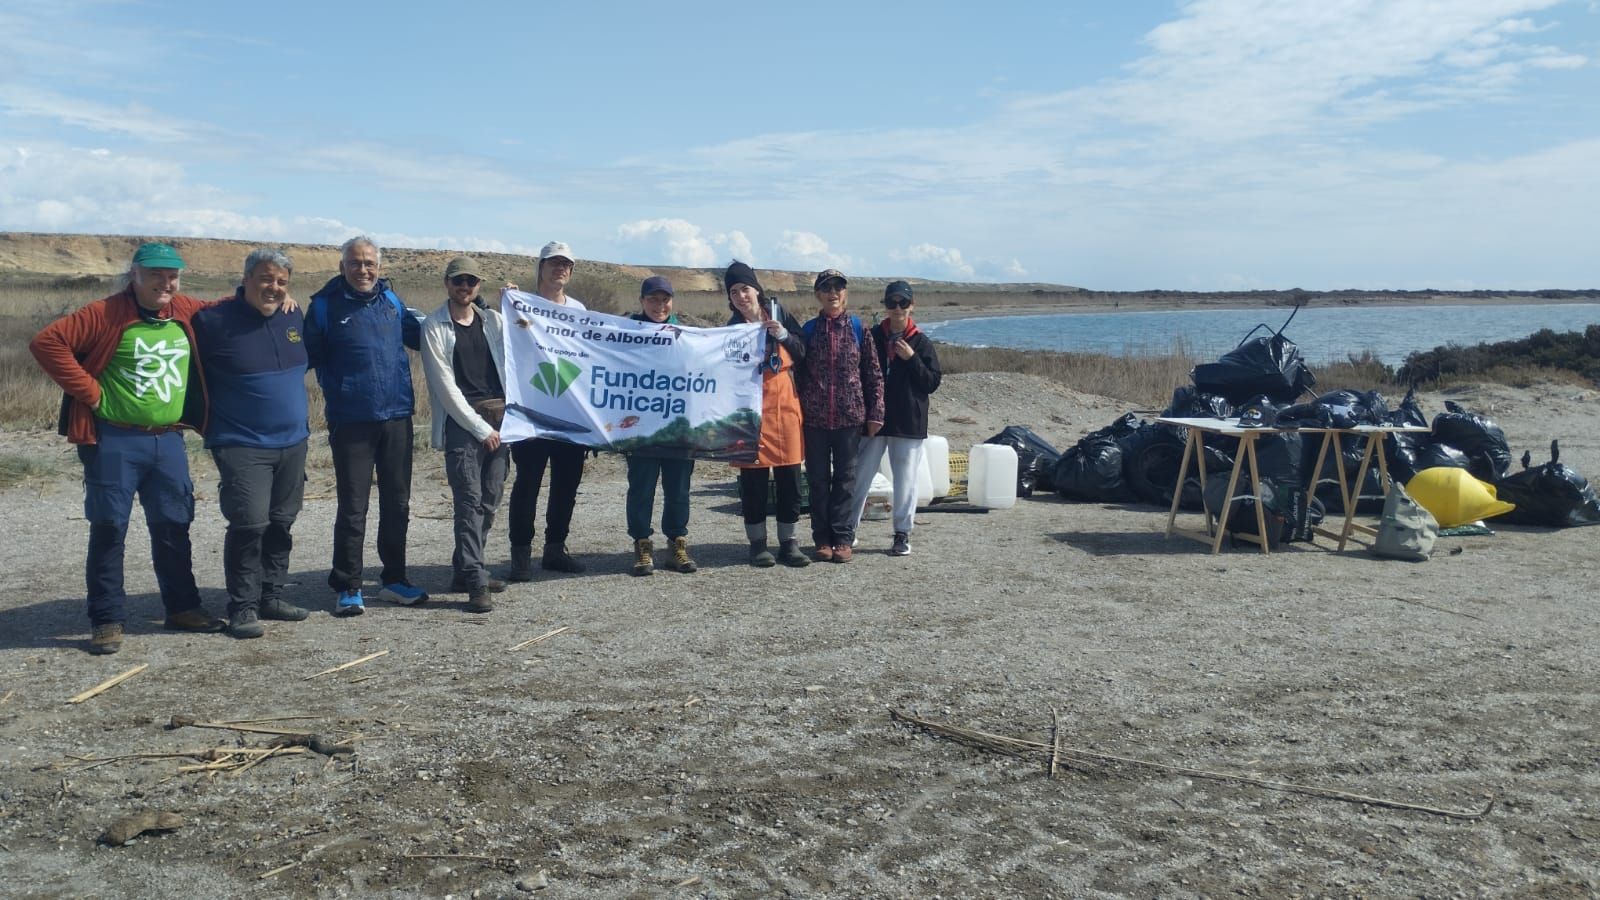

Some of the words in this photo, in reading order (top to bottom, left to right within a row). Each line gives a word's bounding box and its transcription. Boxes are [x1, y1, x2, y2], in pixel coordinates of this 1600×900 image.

[513, 300, 575, 323] Cuentos
[546, 325, 579, 338] mar
[582, 329, 602, 341] de
[605, 331, 673, 346] Alborán
[591, 365, 717, 393] Fundación
[590, 387, 686, 419] Unicaja
